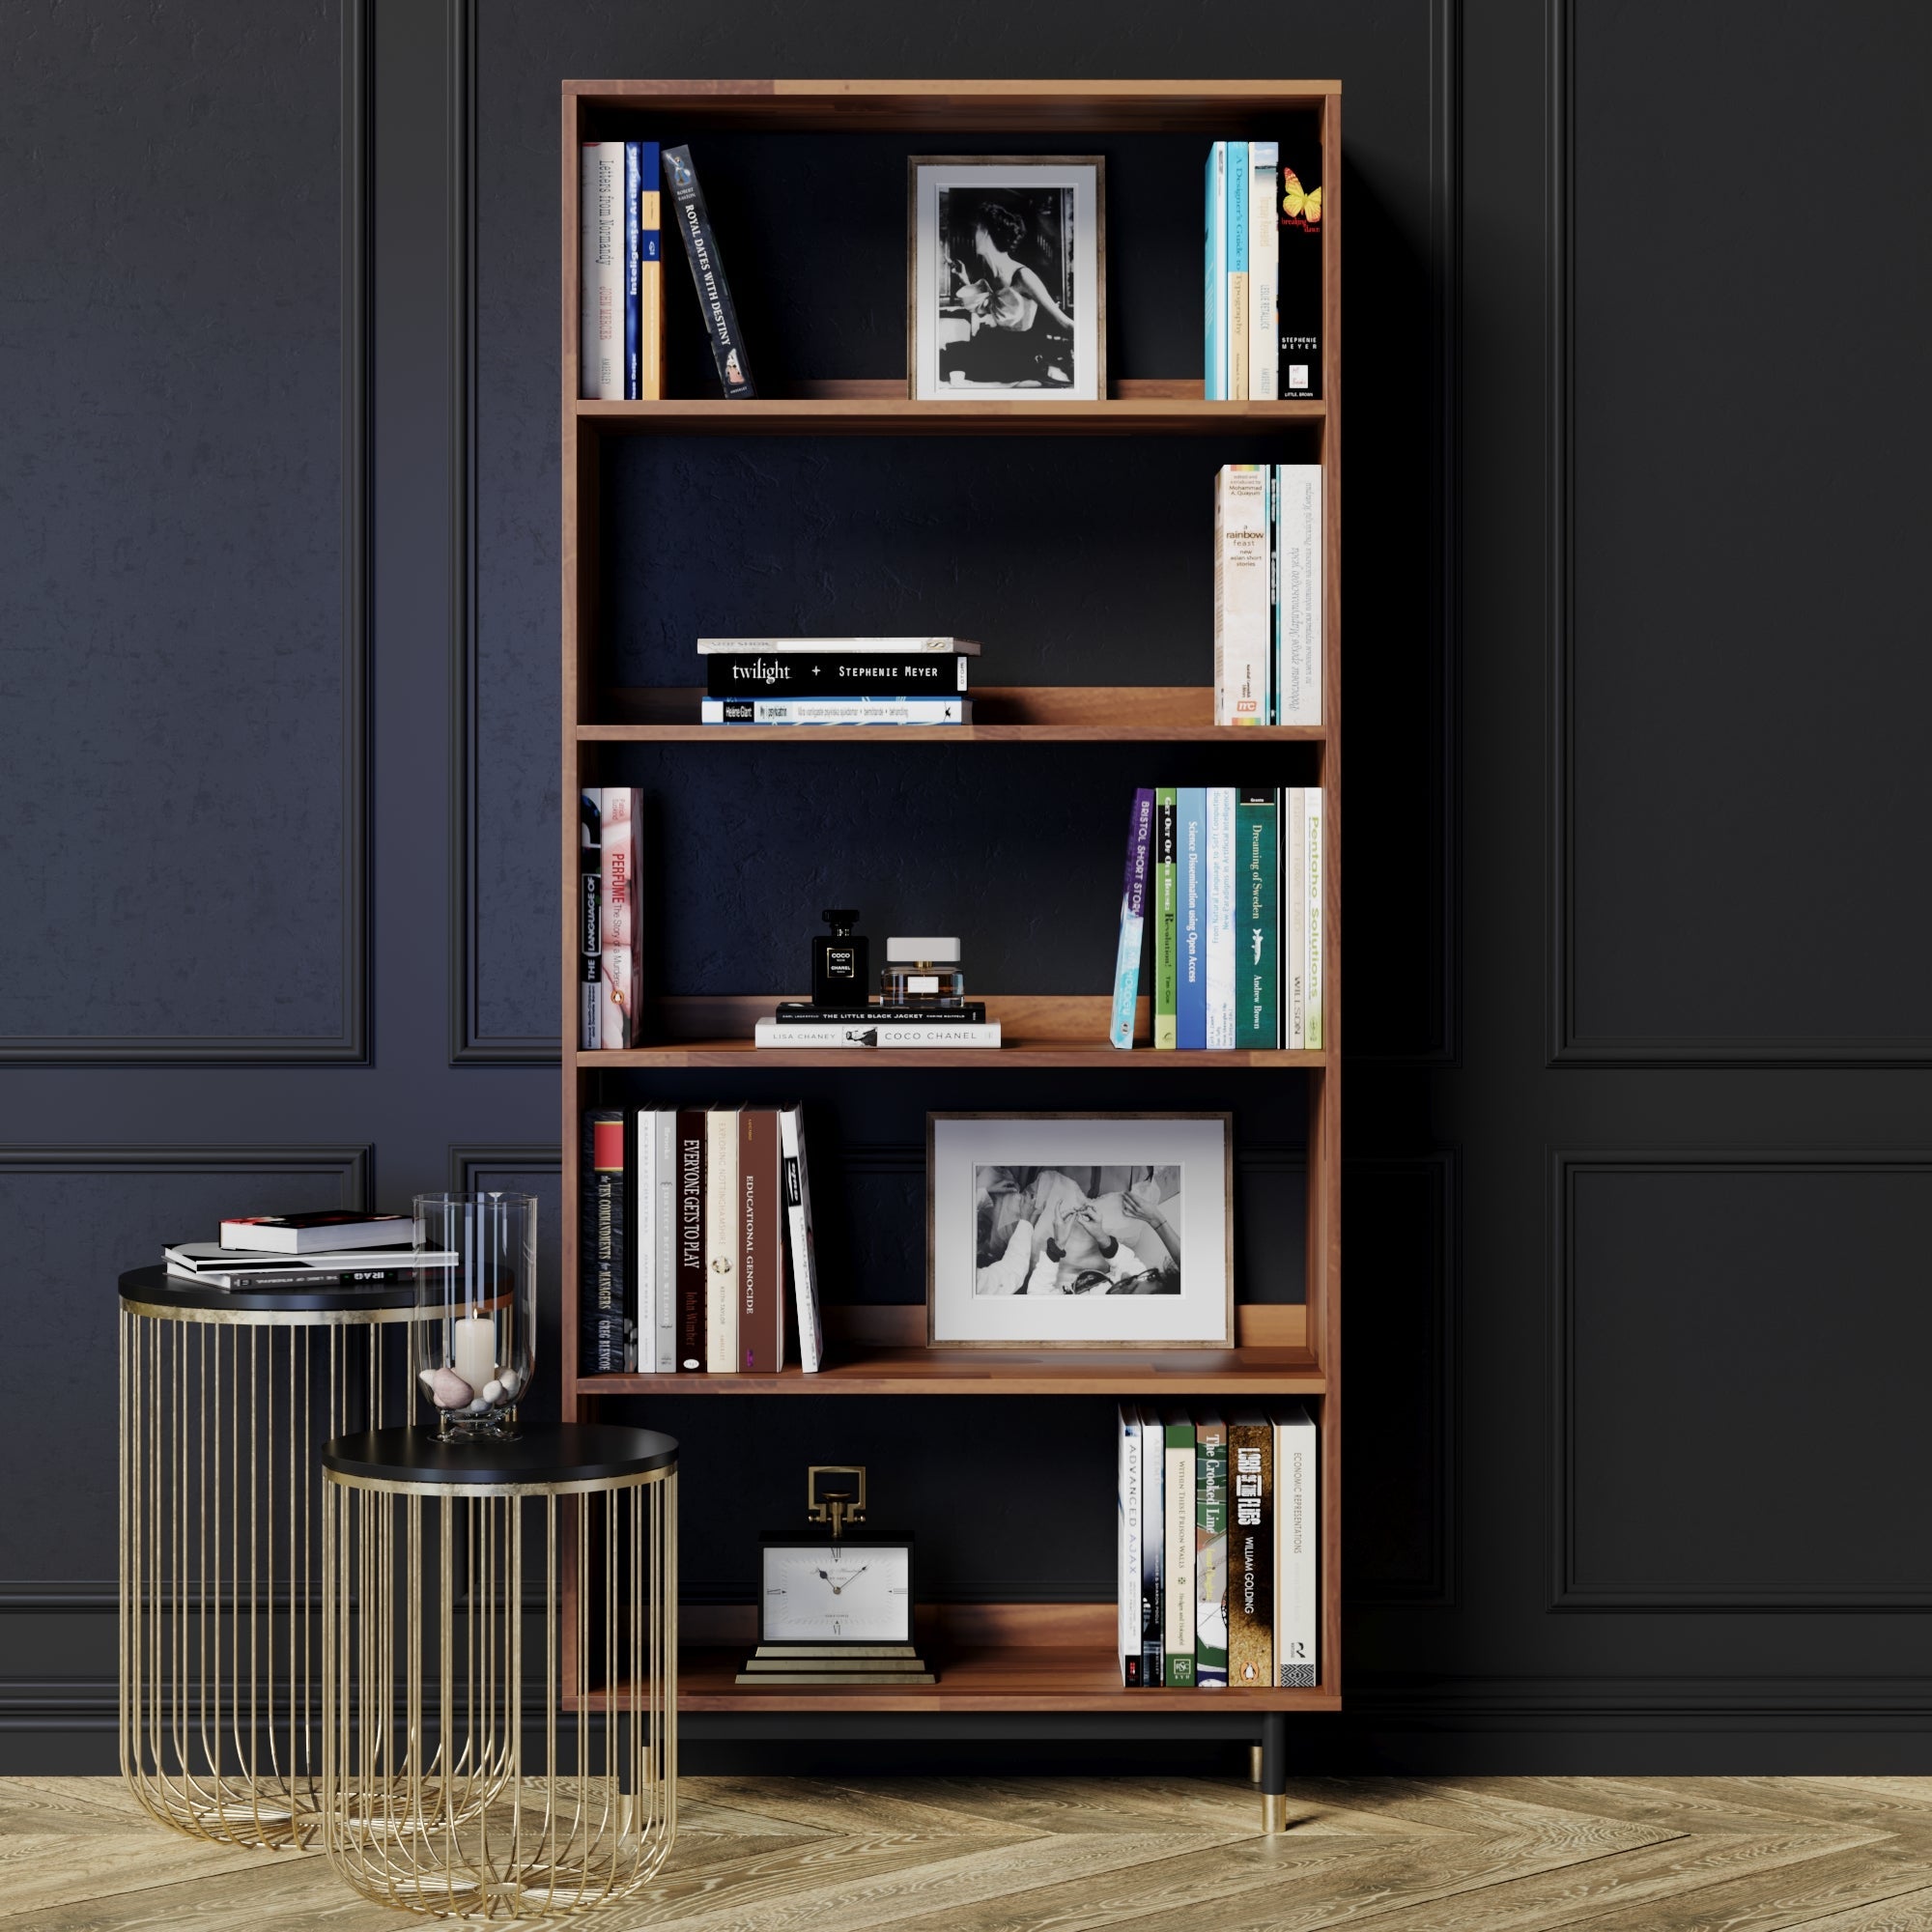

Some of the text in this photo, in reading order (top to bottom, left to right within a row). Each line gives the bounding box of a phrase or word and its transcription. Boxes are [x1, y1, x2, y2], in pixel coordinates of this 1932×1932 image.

[595, 159, 614, 267] Letters from Normandy
[1235, 167, 1243, 222] Designer's
[685, 204, 702, 238] ROYAL
[694, 238, 711, 270] DATES
[703, 270, 719, 300] WITH
[711, 300, 731, 346] DESTINY
[1236, 259, 1243, 271] to
[1235, 274, 1243, 336] Typography
[1260, 284, 1271, 301] LESLIE
[600, 286, 612, 341] JOHN MERCER
[601, 357, 611, 385] AMBERLEY
[1226, 530, 1264, 539] rainbow
[732, 657, 938, 685] twilight STEPHENIE MEYER
[1137, 800, 1151, 842] BRISTOL
[1164, 817, 1173, 837] OUT
[1222, 789, 1231, 831] Intelligence
[1134, 844, 1147, 880] SHORT
[1164, 838, 1173, 854] OF
[587, 876, 596, 893] OF
[612, 853, 625, 904] PERFUME
[1211, 861, 1221, 896] Language
[1250, 824, 1264, 920] Dreaming of Sweden
[612, 904, 622, 919] The
[1185, 821, 1198, 983] Science Dissemination using Open Access
[1222, 874, 1231, 912] Paradigms
[1311, 816, 1320, 998] Pentaho Solutions
[587, 893, 596, 952] LANGUAGE
[611, 920, 622, 939] Story
[587, 958, 596, 980] THE
[612, 955, 622, 987] Murderer
[1253, 974, 1263, 1030] Andrew Brown
[885, 1032, 922, 1040] COCO
[598, 1183, 611, 1198] TEN
[683, 1138, 700, 1269] EVERYONE GETS TO PLAY
[718, 1122, 726, 1245] EXPLORING NOTTINGHAMSHIRE
[598, 1198, 611, 1260] COMMANDMENTS
[746, 1175, 754, 1315] EDUCATIONAL GENOCIDE
[354, 1271, 384, 1280] IRAQ
[598, 1270, 611, 1310] MANAGERS
[686, 1291, 698, 1312] John
[598, 1320, 611, 1371] GREG BLENCOE
[686, 1312, 698, 1347] Wimber
[1206, 1434, 1220, 1458] The
[1237, 1447, 1262, 1473] LORD
[1128, 1443, 1137, 1527] ADVANCED
[1206, 1459, 1220, 1505] Crooked
[1293, 1452, 1303, 1492] ECONOMIC
[1178, 1460, 1186, 1569] WITHIN THESE PRISON WALLS
[1206, 1507, 1220, 1534] Line
[1237, 1497, 1262, 1525] FLIES
[1293, 1493, 1303, 1554] REPRESENTATIONS
[1128, 1534, 1137, 1575] AJAX
[1244, 1536, 1255, 1614] WILLIAM GOLDING
